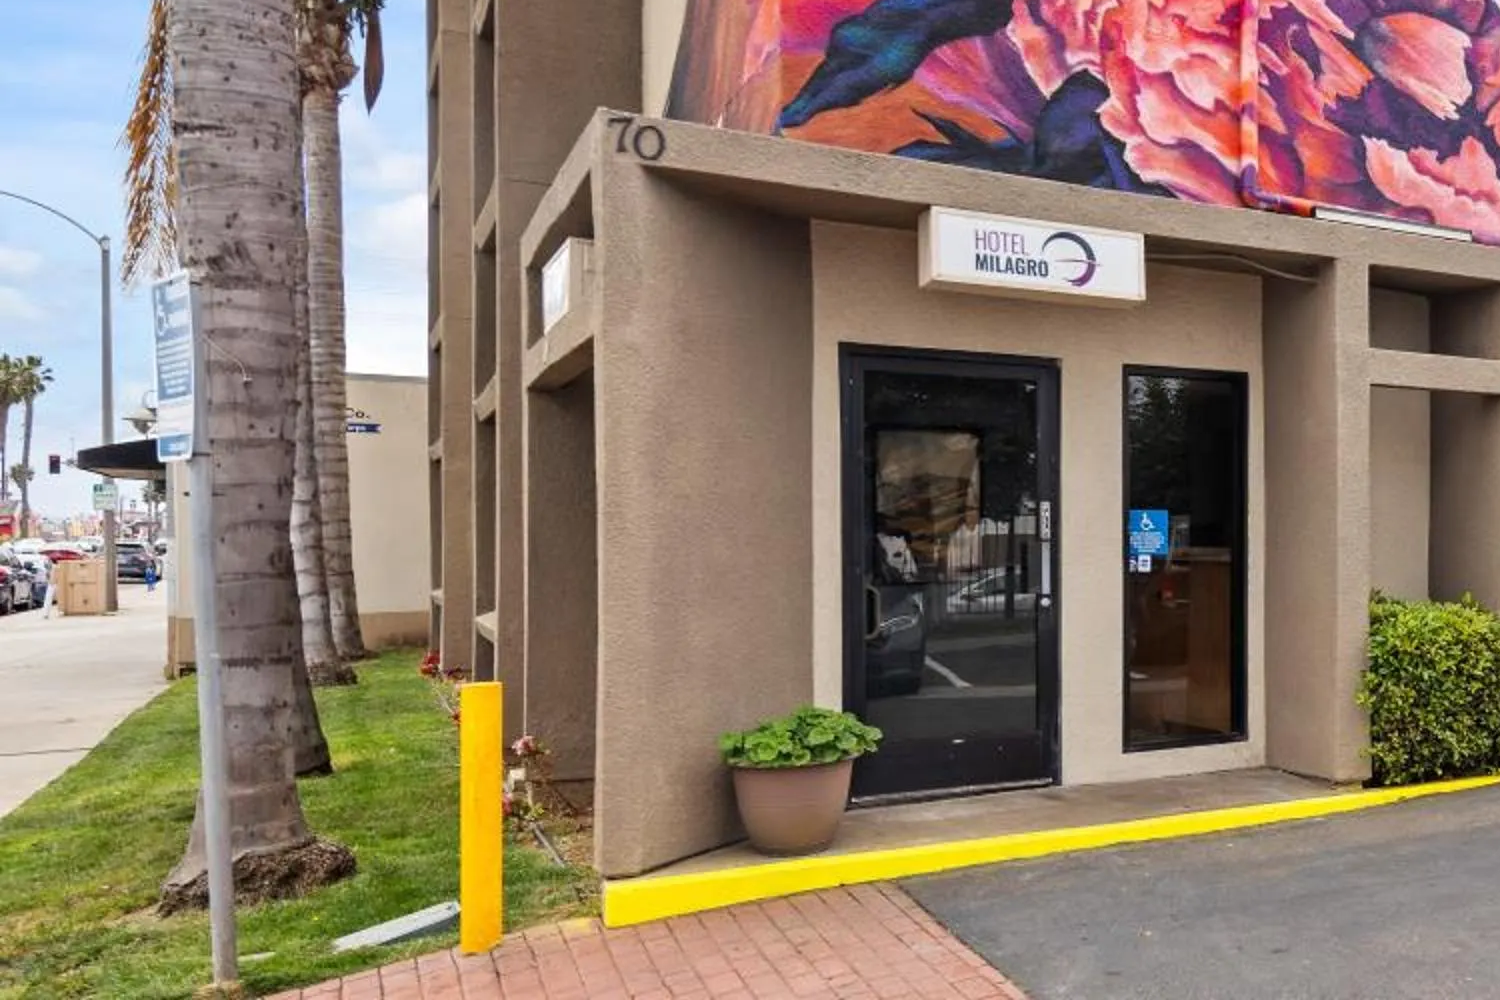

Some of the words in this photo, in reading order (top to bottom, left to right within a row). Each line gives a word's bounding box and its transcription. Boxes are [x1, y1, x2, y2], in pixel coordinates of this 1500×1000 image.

[607, 117, 666, 161] 70
[974, 229, 1029, 256] HOTEL
[974, 253, 1050, 278] MILAGRO
